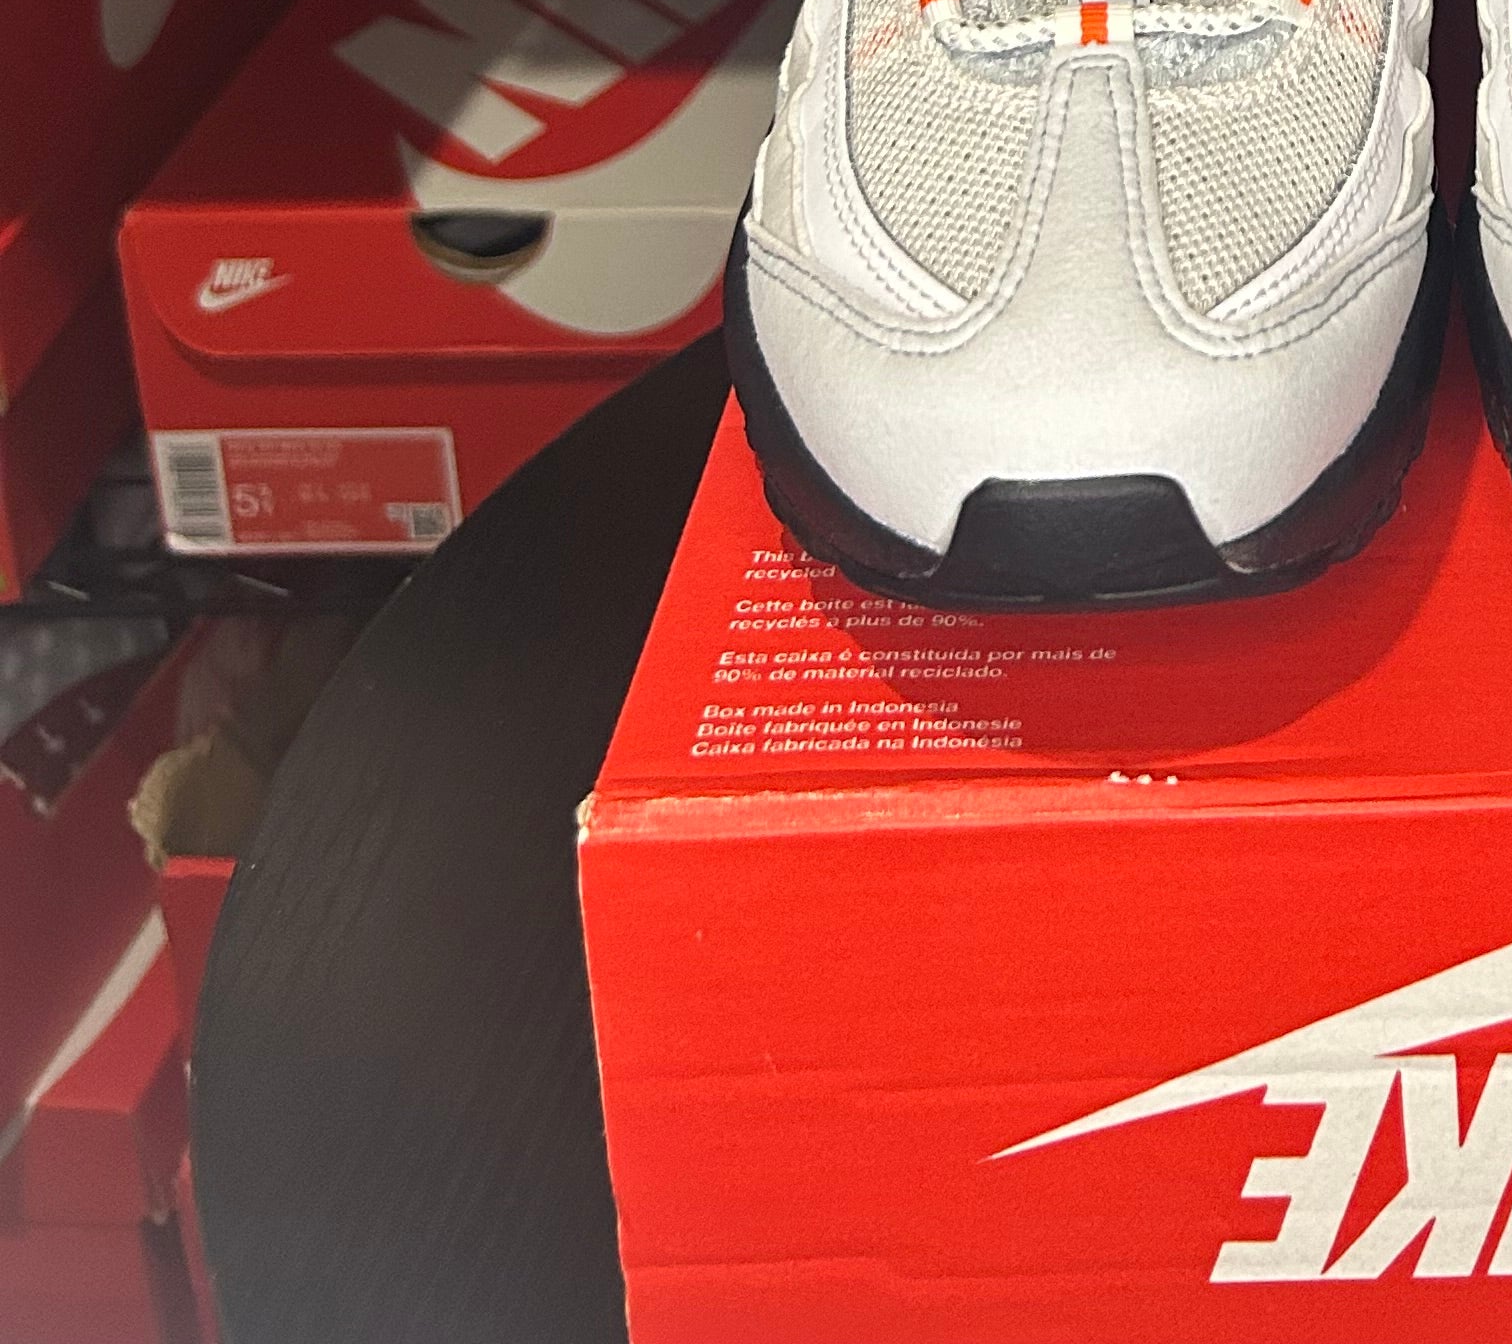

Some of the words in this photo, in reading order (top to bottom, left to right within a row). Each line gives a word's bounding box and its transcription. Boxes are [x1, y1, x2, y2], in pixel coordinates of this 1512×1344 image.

[751, 549, 794, 565] This
[744, 564, 836, 580] recycled
[735, 598, 794, 613] Cette
[860, 598, 894, 610] est
[728, 613, 821, 631] recyclés
[845, 613, 891, 629] plus
[898, 613, 925, 628] de
[717, 650, 768, 667] Esta
[773, 649, 832, 664] caixa
[987, 648, 1026, 665] por
[1030, 646, 1083, 662] mais
[1088, 645, 1117, 662] de
[712, 667, 764, 684] 90%
[769, 666, 797, 682] de
[802, 664, 894, 681] material
[703, 704, 746, 719] Box
[752, 700, 816, 716] made
[821, 700, 843, 714] in
[849, 699, 959, 714] Indonesia
[762, 718, 872, 736] fabriquée
[877, 718, 906, 732] en
[690, 740, 756, 757] Caixa
[762, 736, 870, 753] fabricada
[876, 736, 905, 750] na
